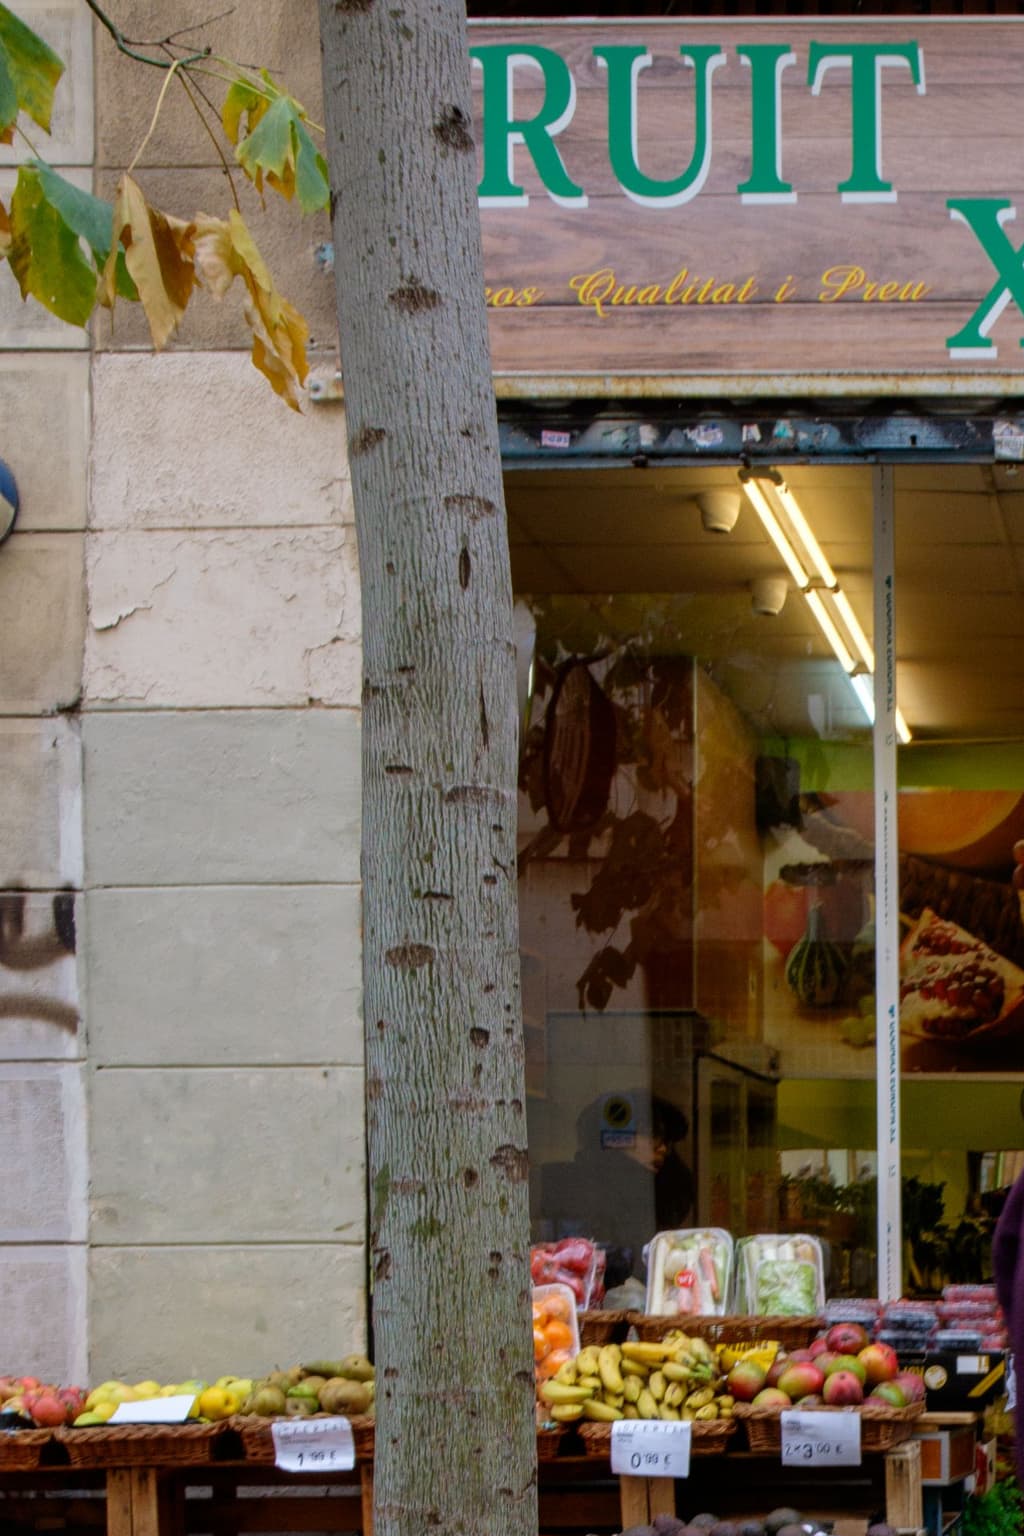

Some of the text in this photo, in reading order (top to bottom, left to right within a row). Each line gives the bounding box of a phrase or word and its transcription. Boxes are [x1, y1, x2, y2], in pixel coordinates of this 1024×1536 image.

[468, 41, 927, 208] RUIT
[569, 266, 757, 318] Qualitat
[774, 274, 797, 303] i
[818, 264, 931, 302] Preu
